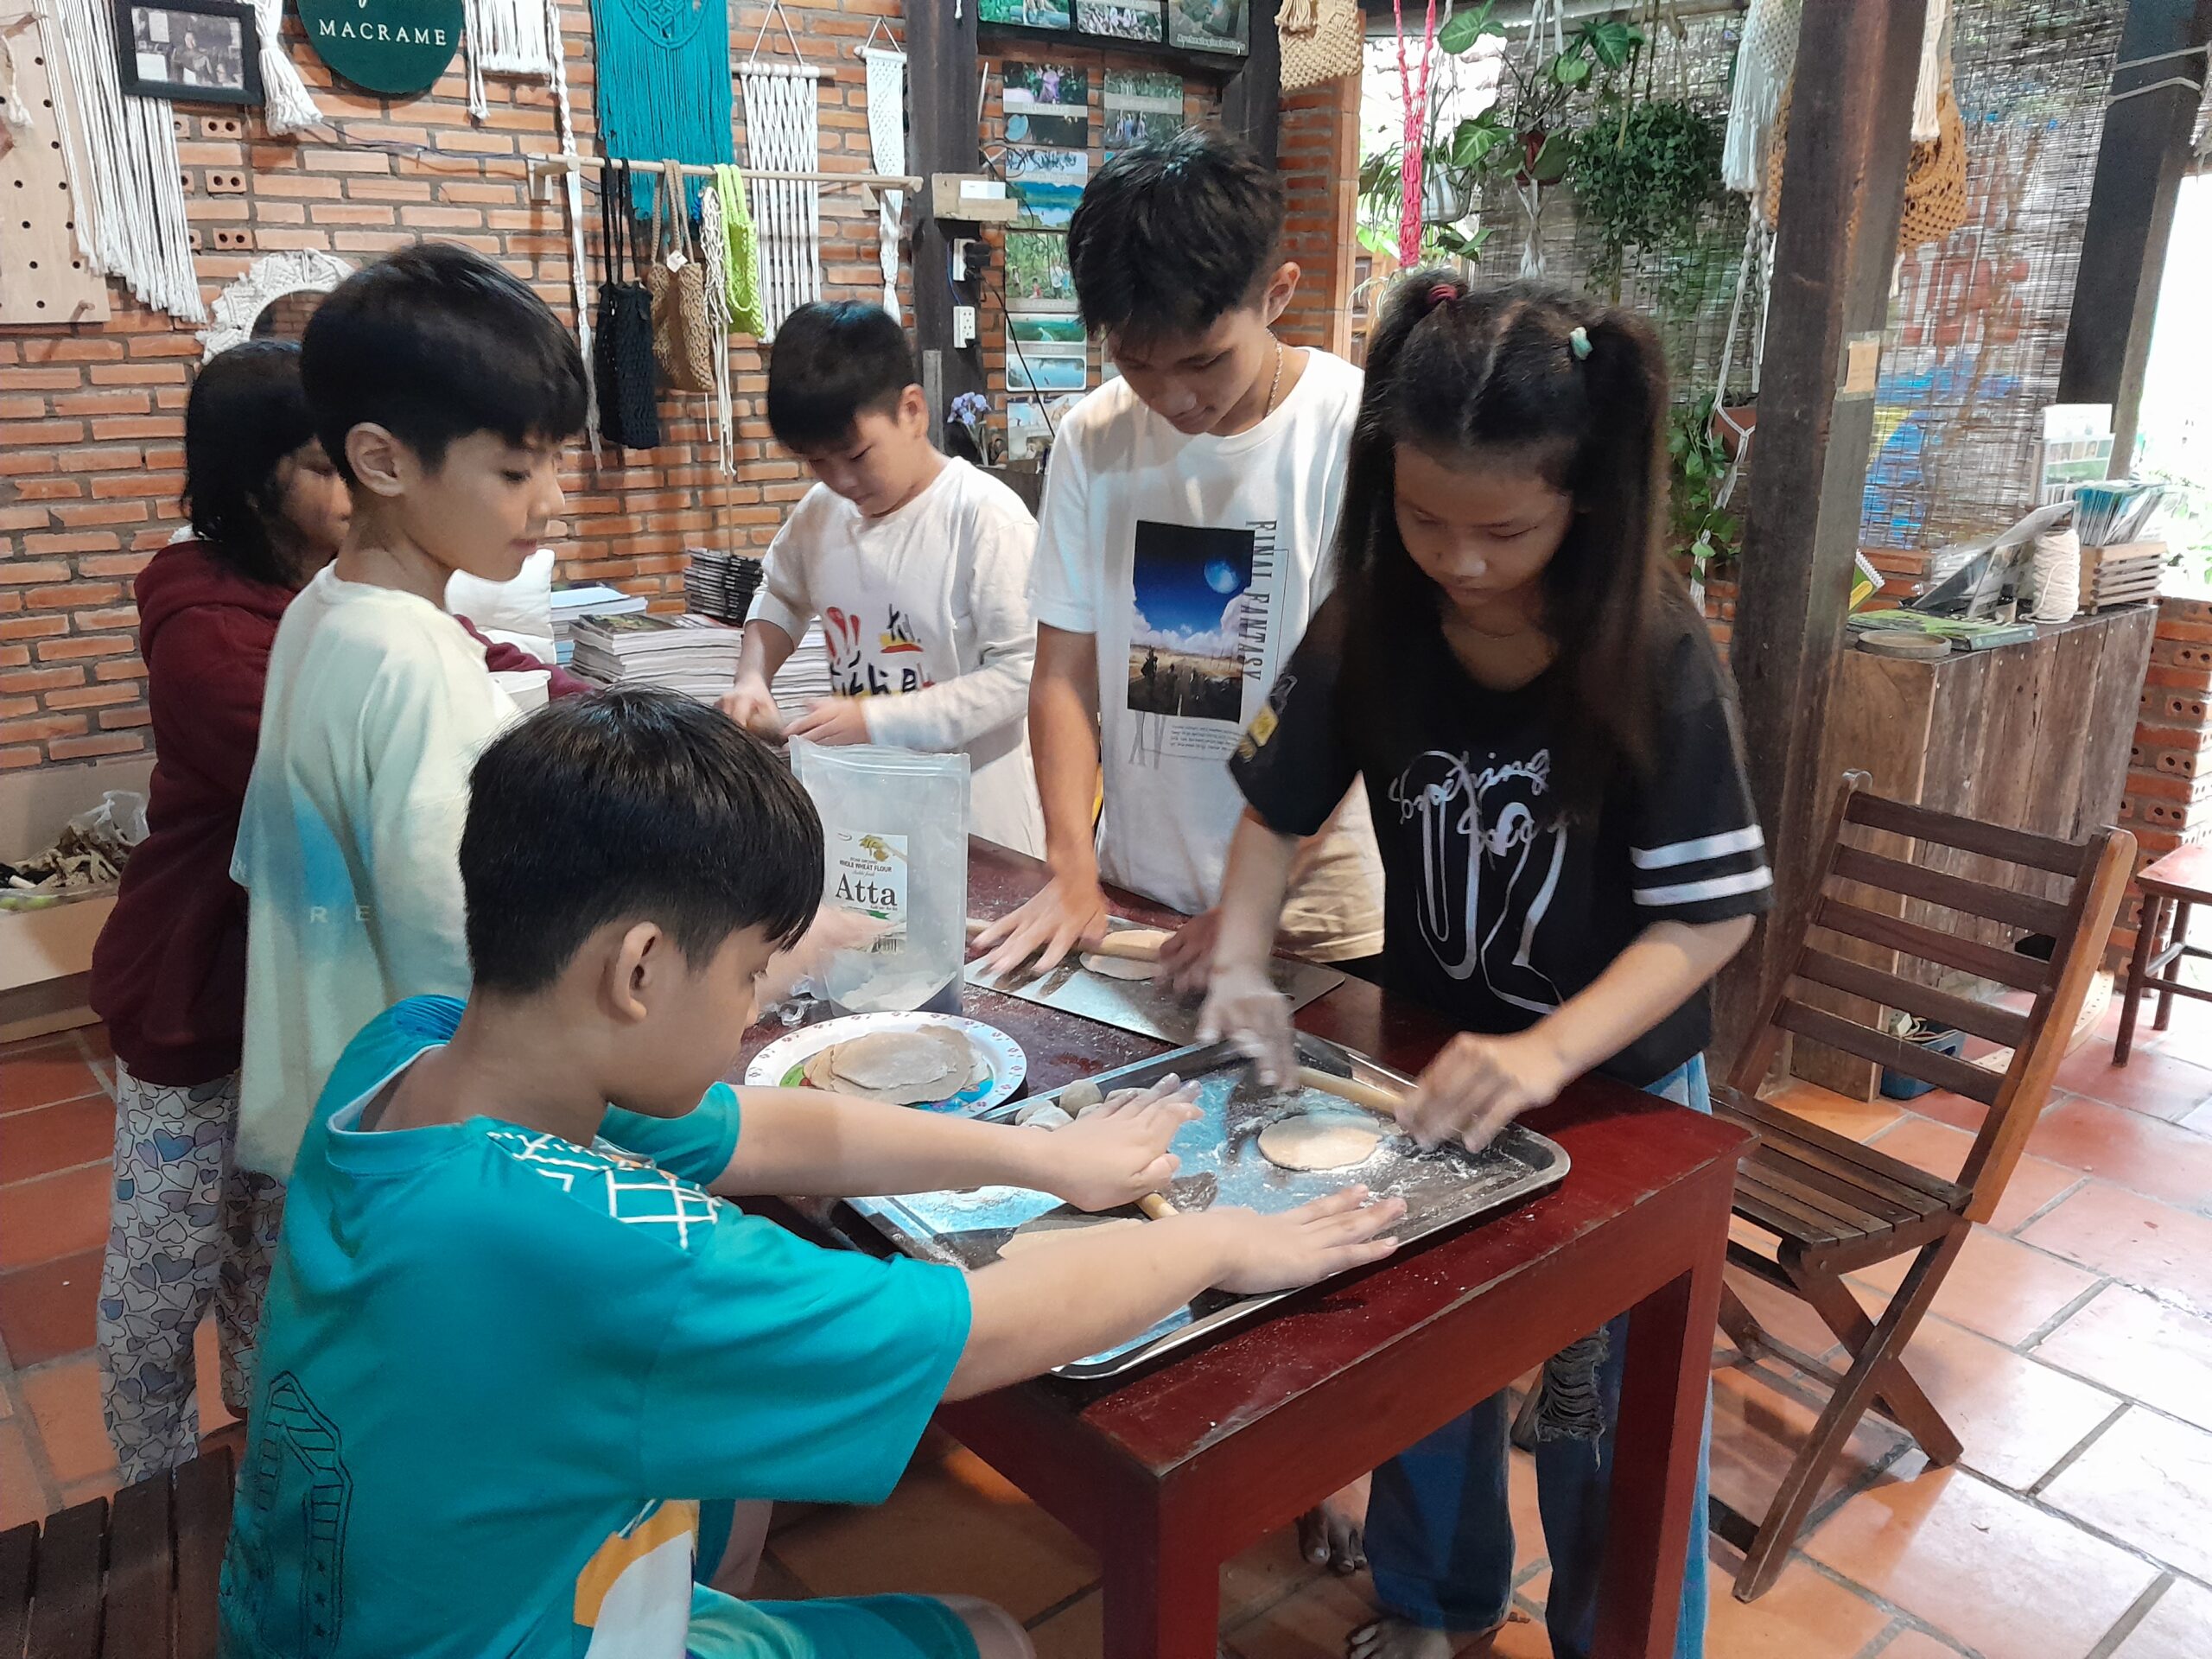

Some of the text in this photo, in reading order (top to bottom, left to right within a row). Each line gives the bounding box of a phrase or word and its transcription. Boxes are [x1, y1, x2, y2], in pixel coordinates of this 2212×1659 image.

[319, 19, 447, 46] MACRAME
[1237, 520, 1277, 680] FINAL FANTASY
[835, 873, 898, 906] Atta
